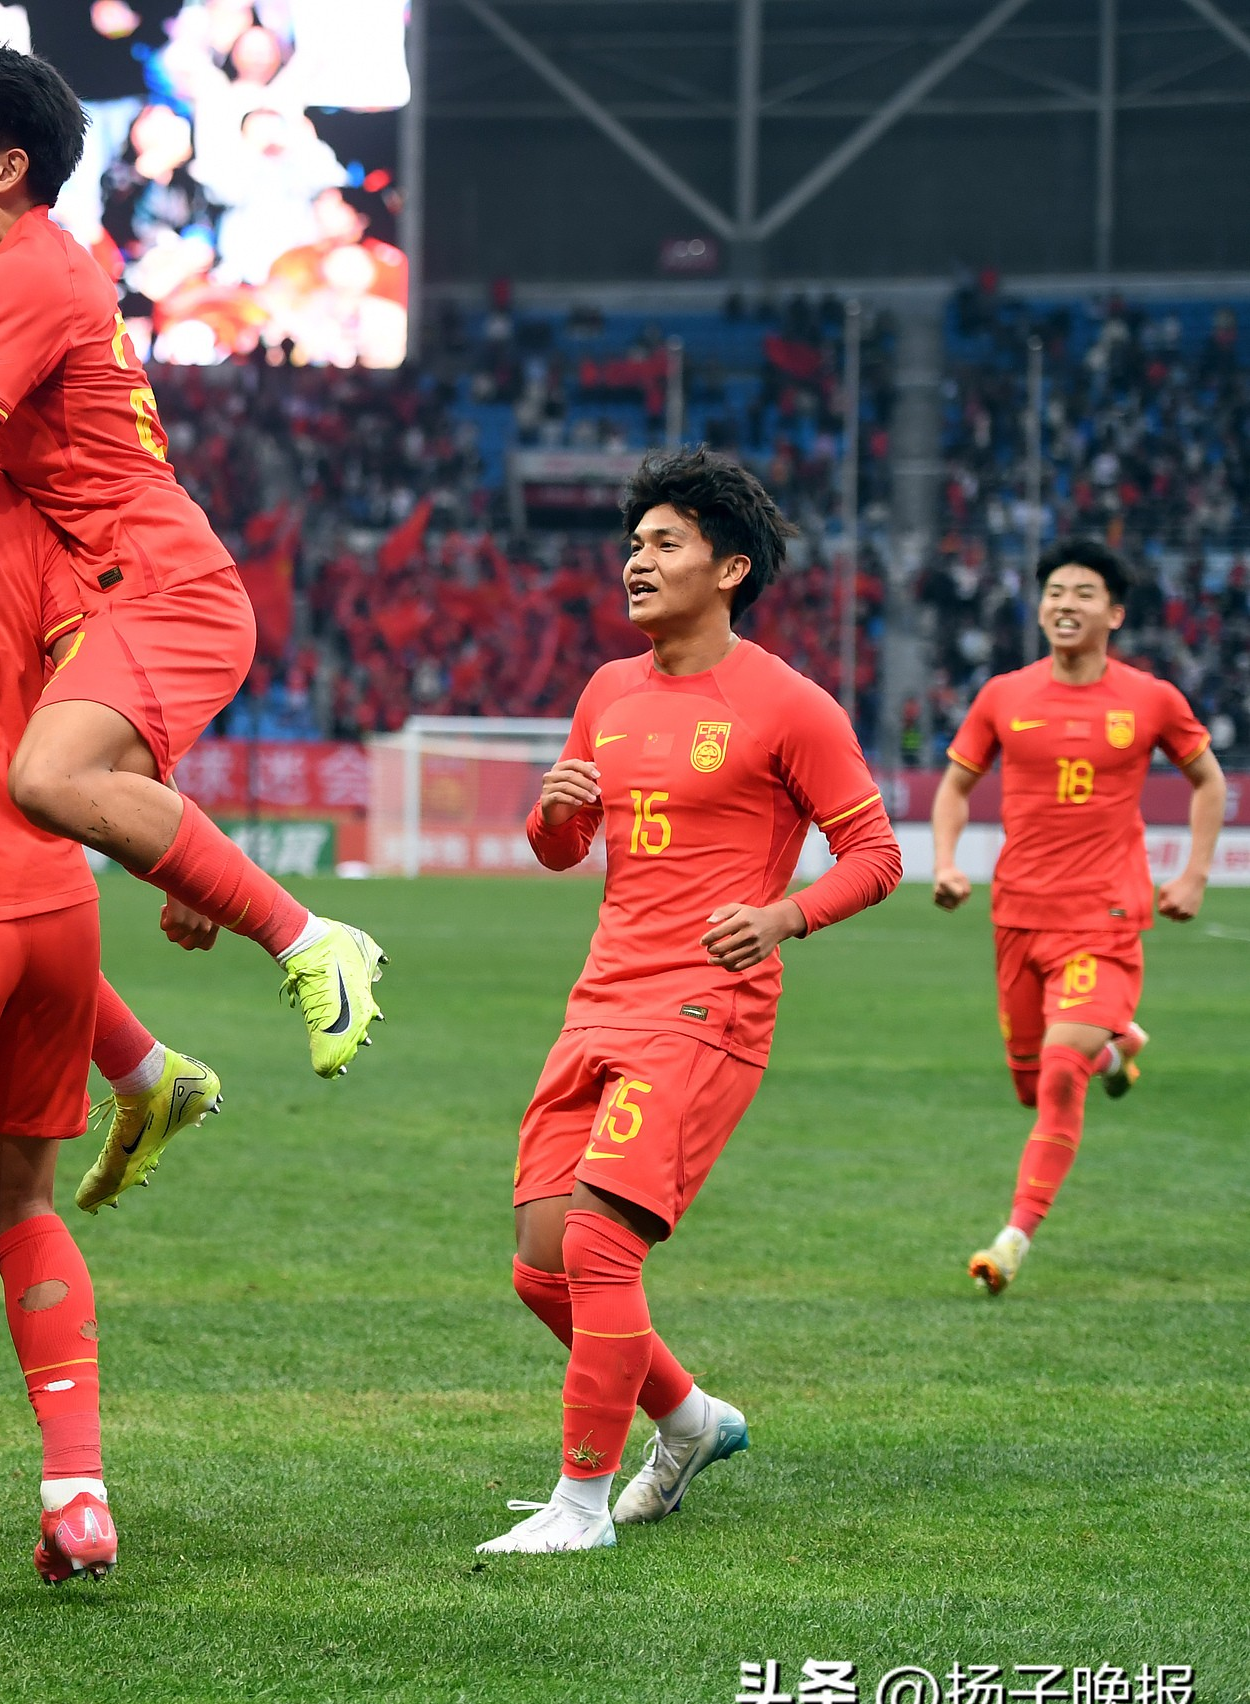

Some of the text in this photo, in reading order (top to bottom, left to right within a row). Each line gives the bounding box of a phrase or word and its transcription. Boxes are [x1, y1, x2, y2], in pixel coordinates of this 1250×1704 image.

[699, 725, 727, 735] CFA
[1056, 757, 1095, 804] 18
[630, 789, 672, 855] 15
[1063, 952, 1097, 994] 18
[598, 1076, 652, 1143] 15
